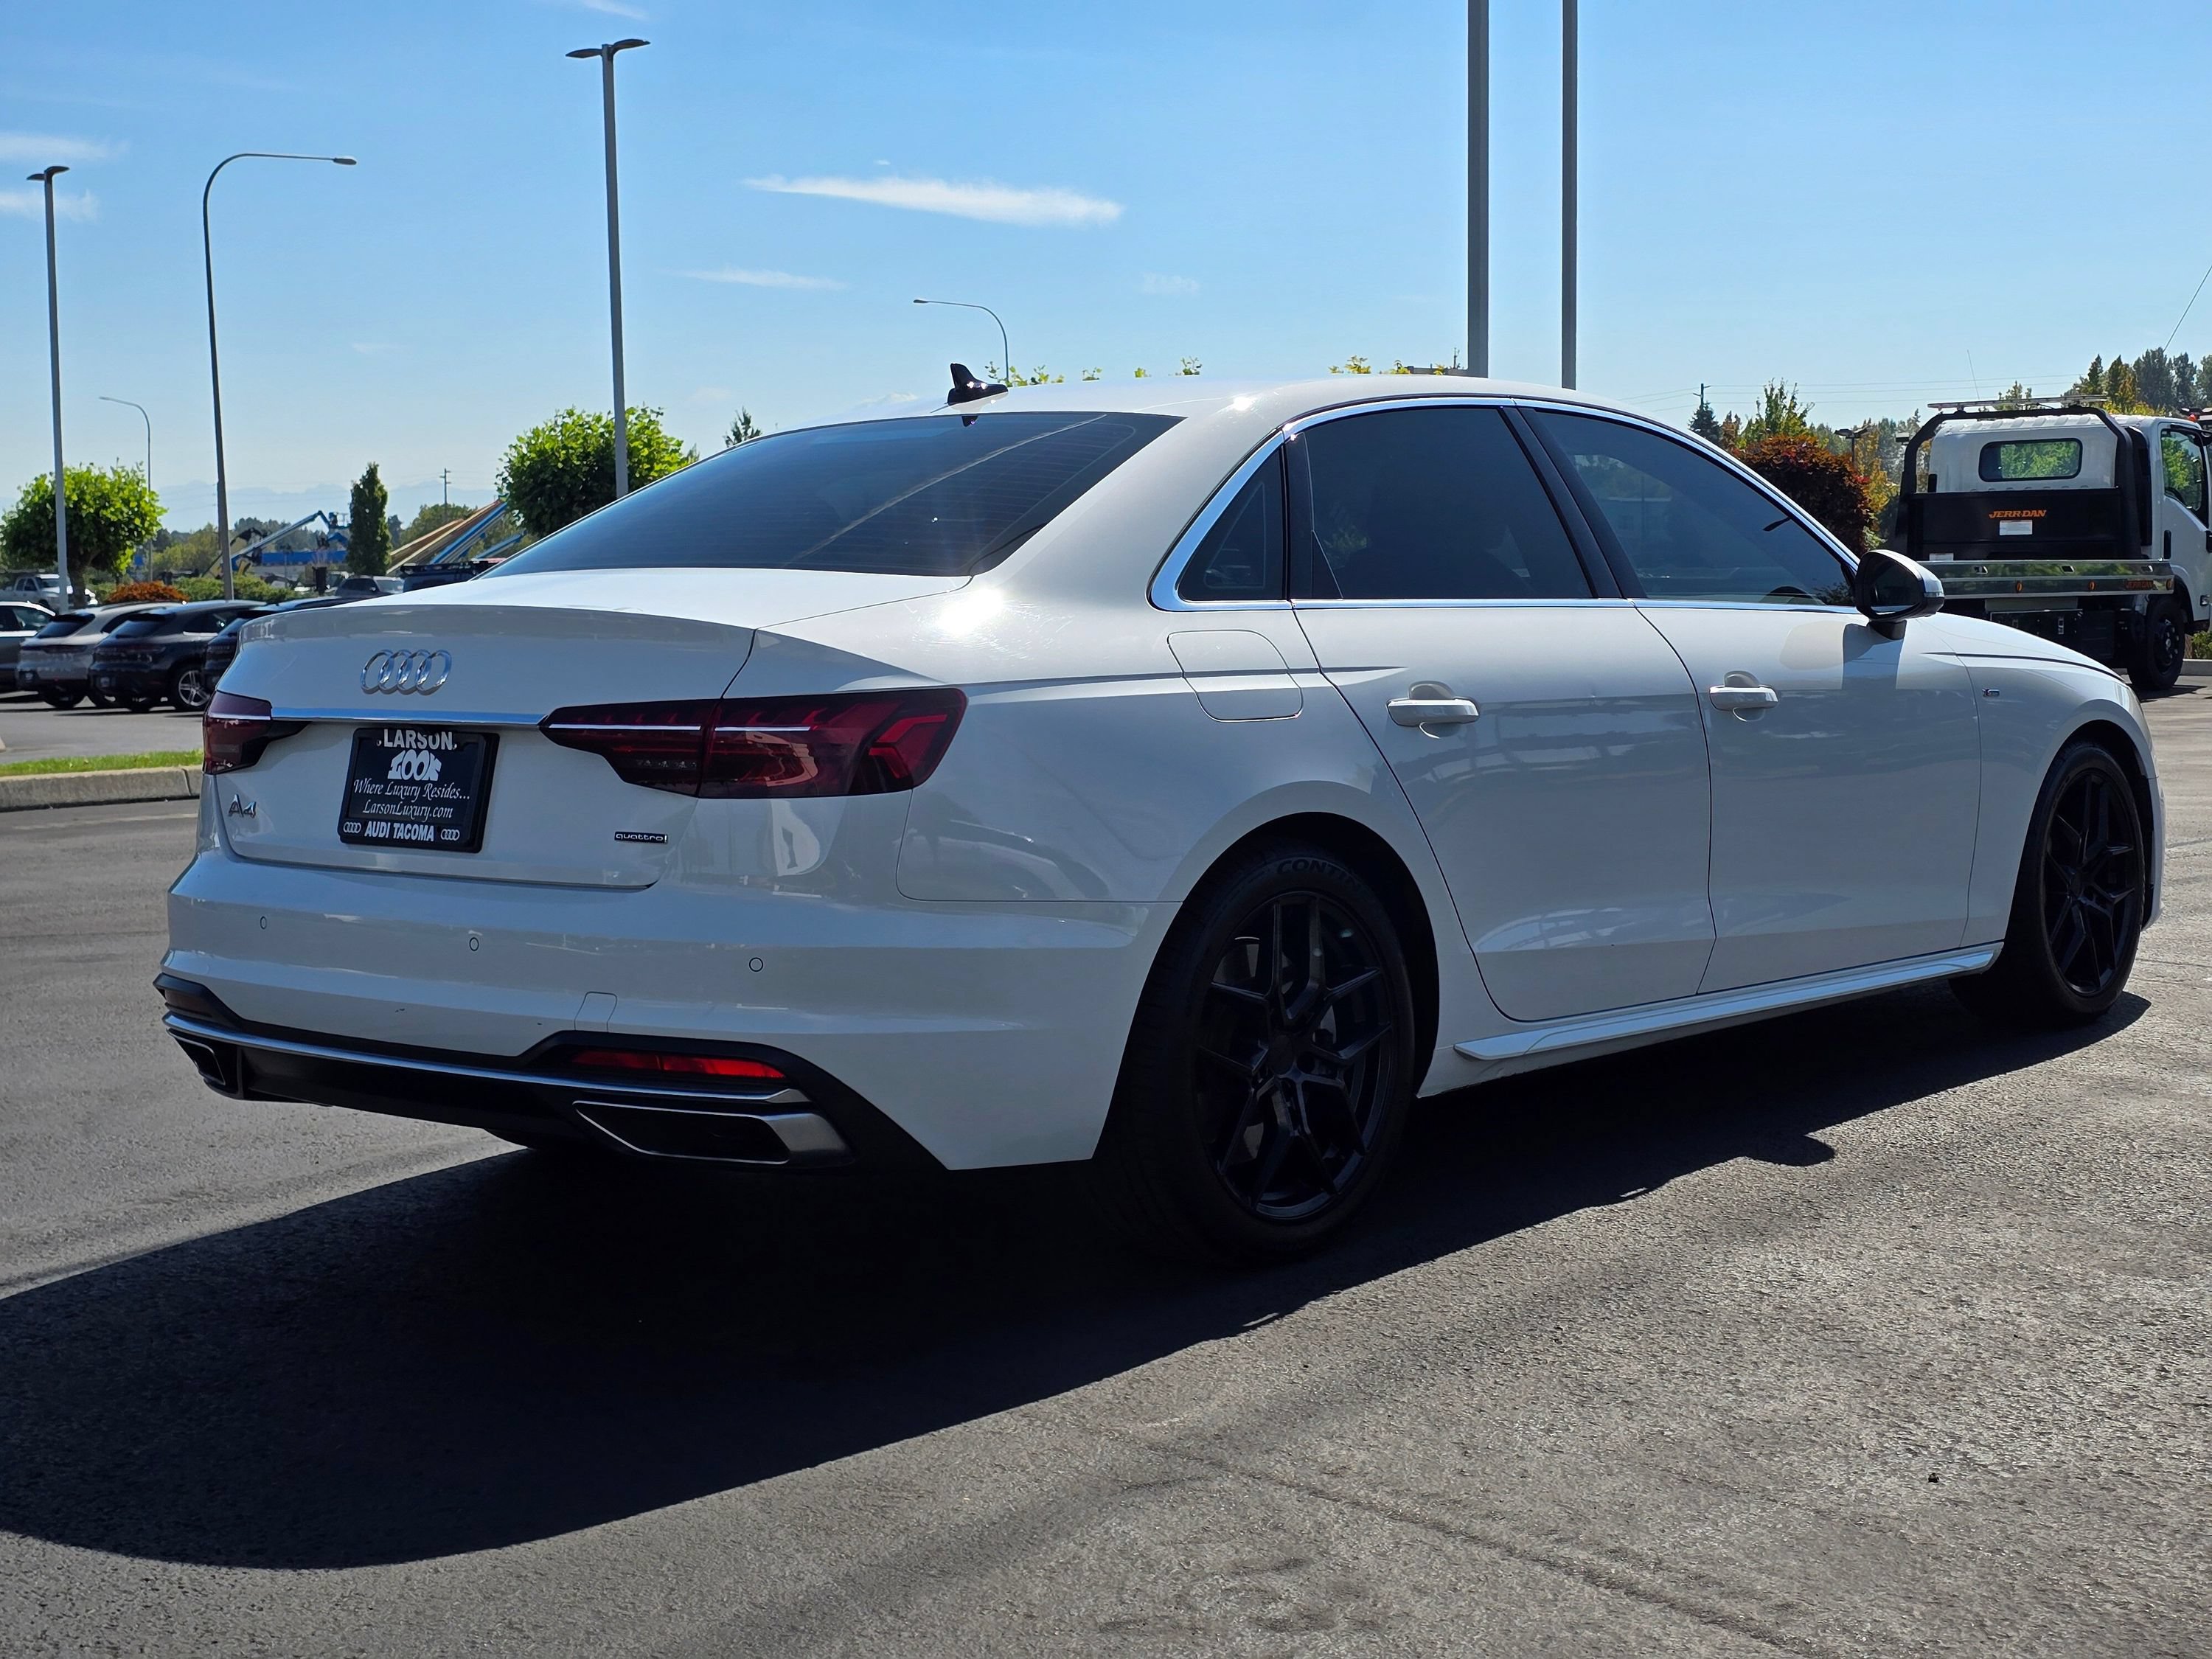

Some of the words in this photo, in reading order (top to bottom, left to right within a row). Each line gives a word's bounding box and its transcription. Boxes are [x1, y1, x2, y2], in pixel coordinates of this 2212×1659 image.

[383, 728, 453, 751] LARSON
[353, 778, 383, 796] Where
[385, 781, 421, 803] Luxury
[362, 799, 454, 823] LarsonLuxury.com
[364, 821, 391, 838] AUDI
[392, 822, 434, 842] TACOMA
[615, 832, 664, 842] quattro
